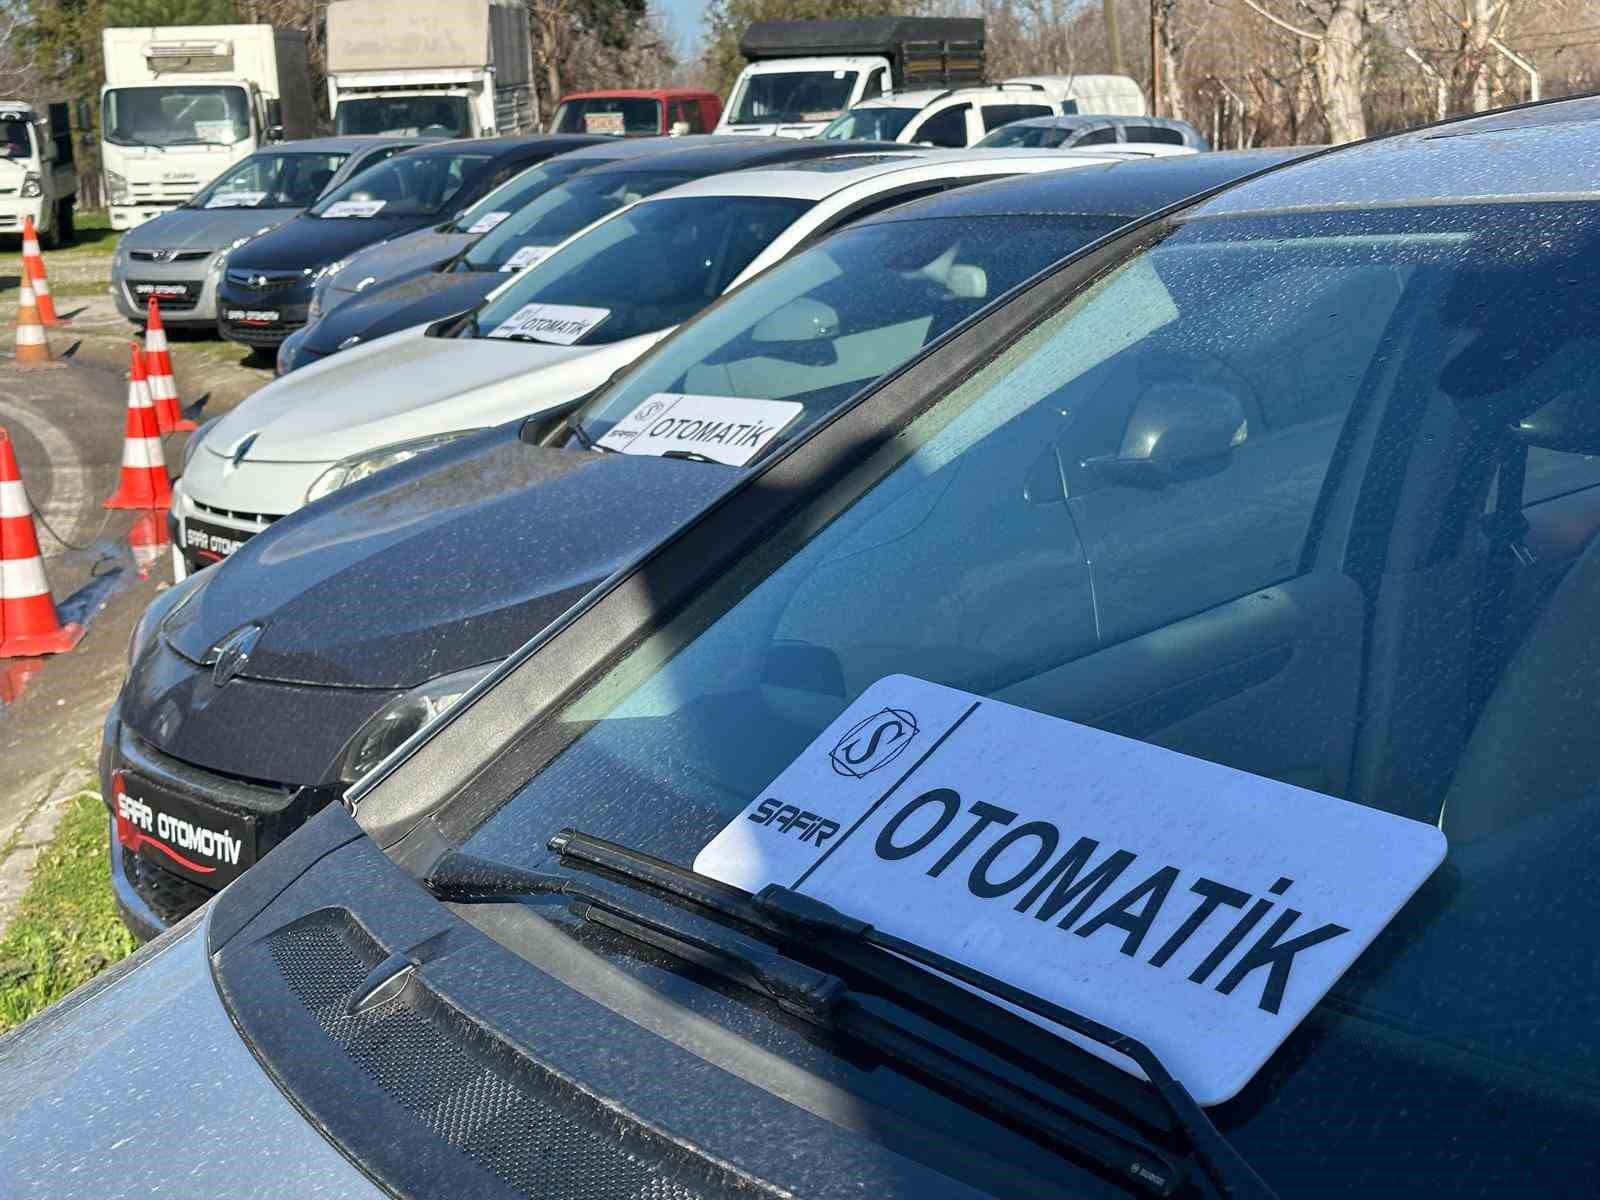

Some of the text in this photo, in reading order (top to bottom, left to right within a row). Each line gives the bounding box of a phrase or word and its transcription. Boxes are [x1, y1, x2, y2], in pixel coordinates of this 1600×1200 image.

[649, 418, 773, 447] OTOMATİK
[157, 812, 242, 865] OTOMOTİV
[875, 787, 1350, 1015] OTOMATİK
